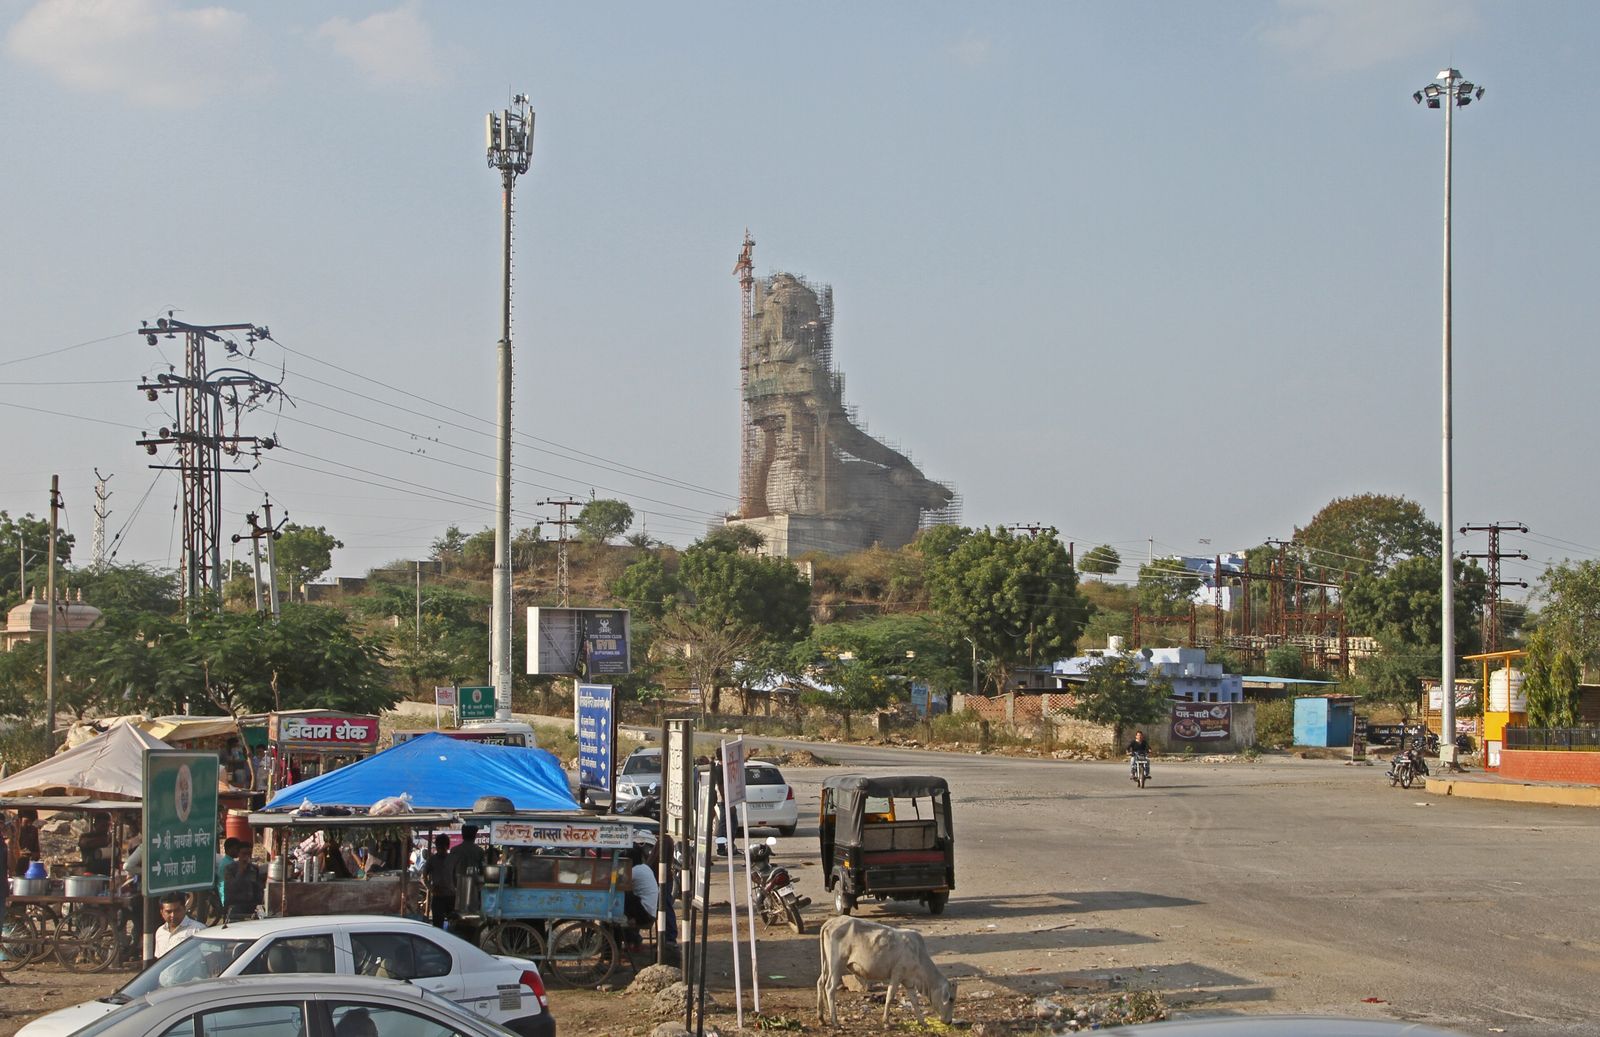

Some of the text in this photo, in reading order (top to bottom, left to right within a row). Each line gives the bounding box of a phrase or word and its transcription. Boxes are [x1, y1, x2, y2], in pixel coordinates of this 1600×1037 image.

[288, 720, 368, 740] बदाम शेक
[1390, 727, 1403, 736] Raj
[1404, 727, 1418, 736] Cafe
[163, 830, 171, 850] श्री
[163, 855, 197, 877] गणेश टेकरी
